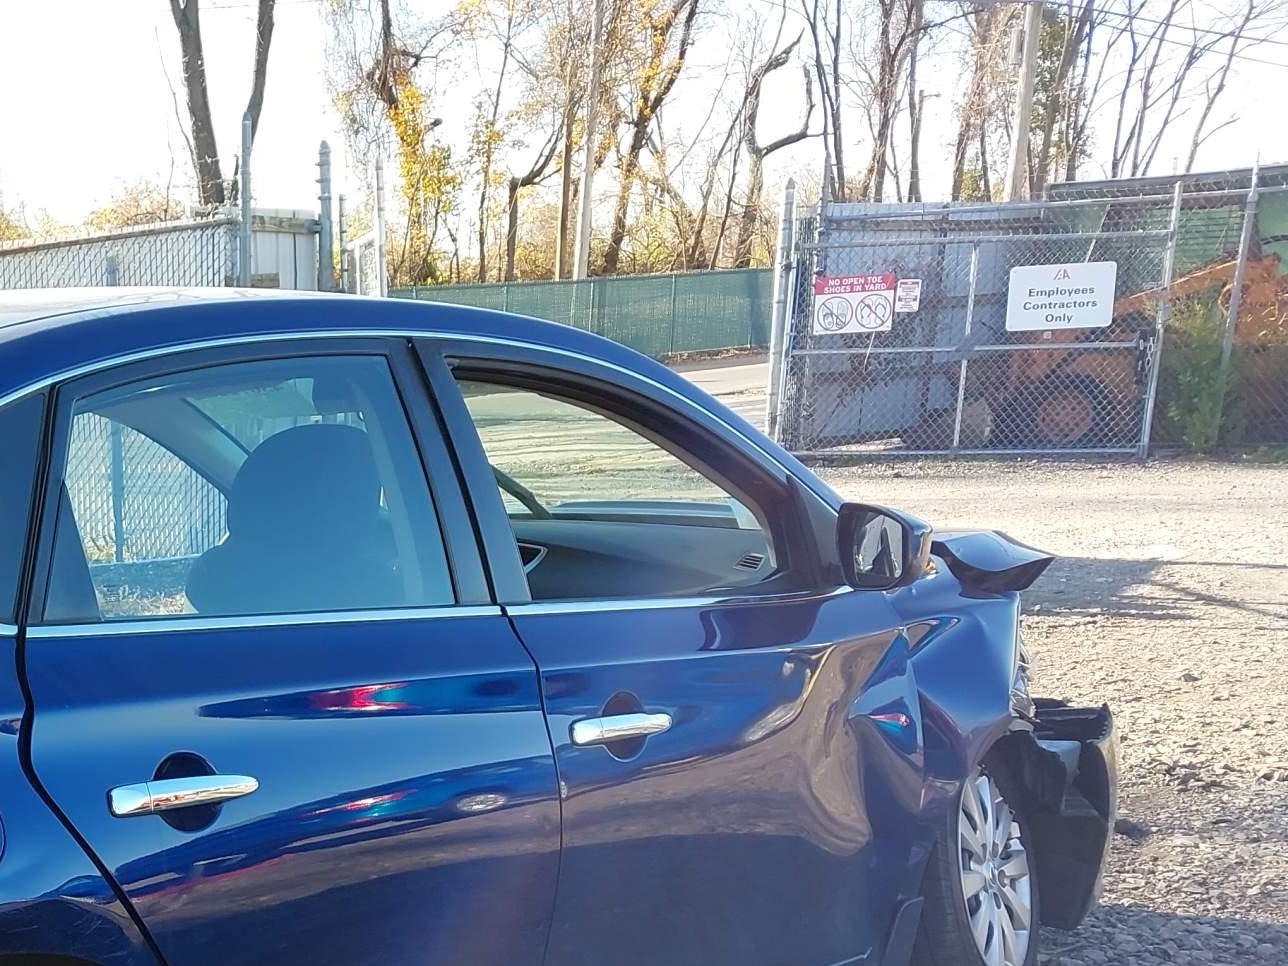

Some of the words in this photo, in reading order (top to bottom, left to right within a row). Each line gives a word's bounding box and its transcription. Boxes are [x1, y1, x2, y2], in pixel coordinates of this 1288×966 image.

[842, 277, 865, 285] OPEN
[824, 286, 851, 294] SHOES
[864, 283, 887, 291] YARD
[1028, 287, 1095, 298] Employees
[1023, 300, 1097, 311] Contractors
[1045, 313, 1073, 323] Only
